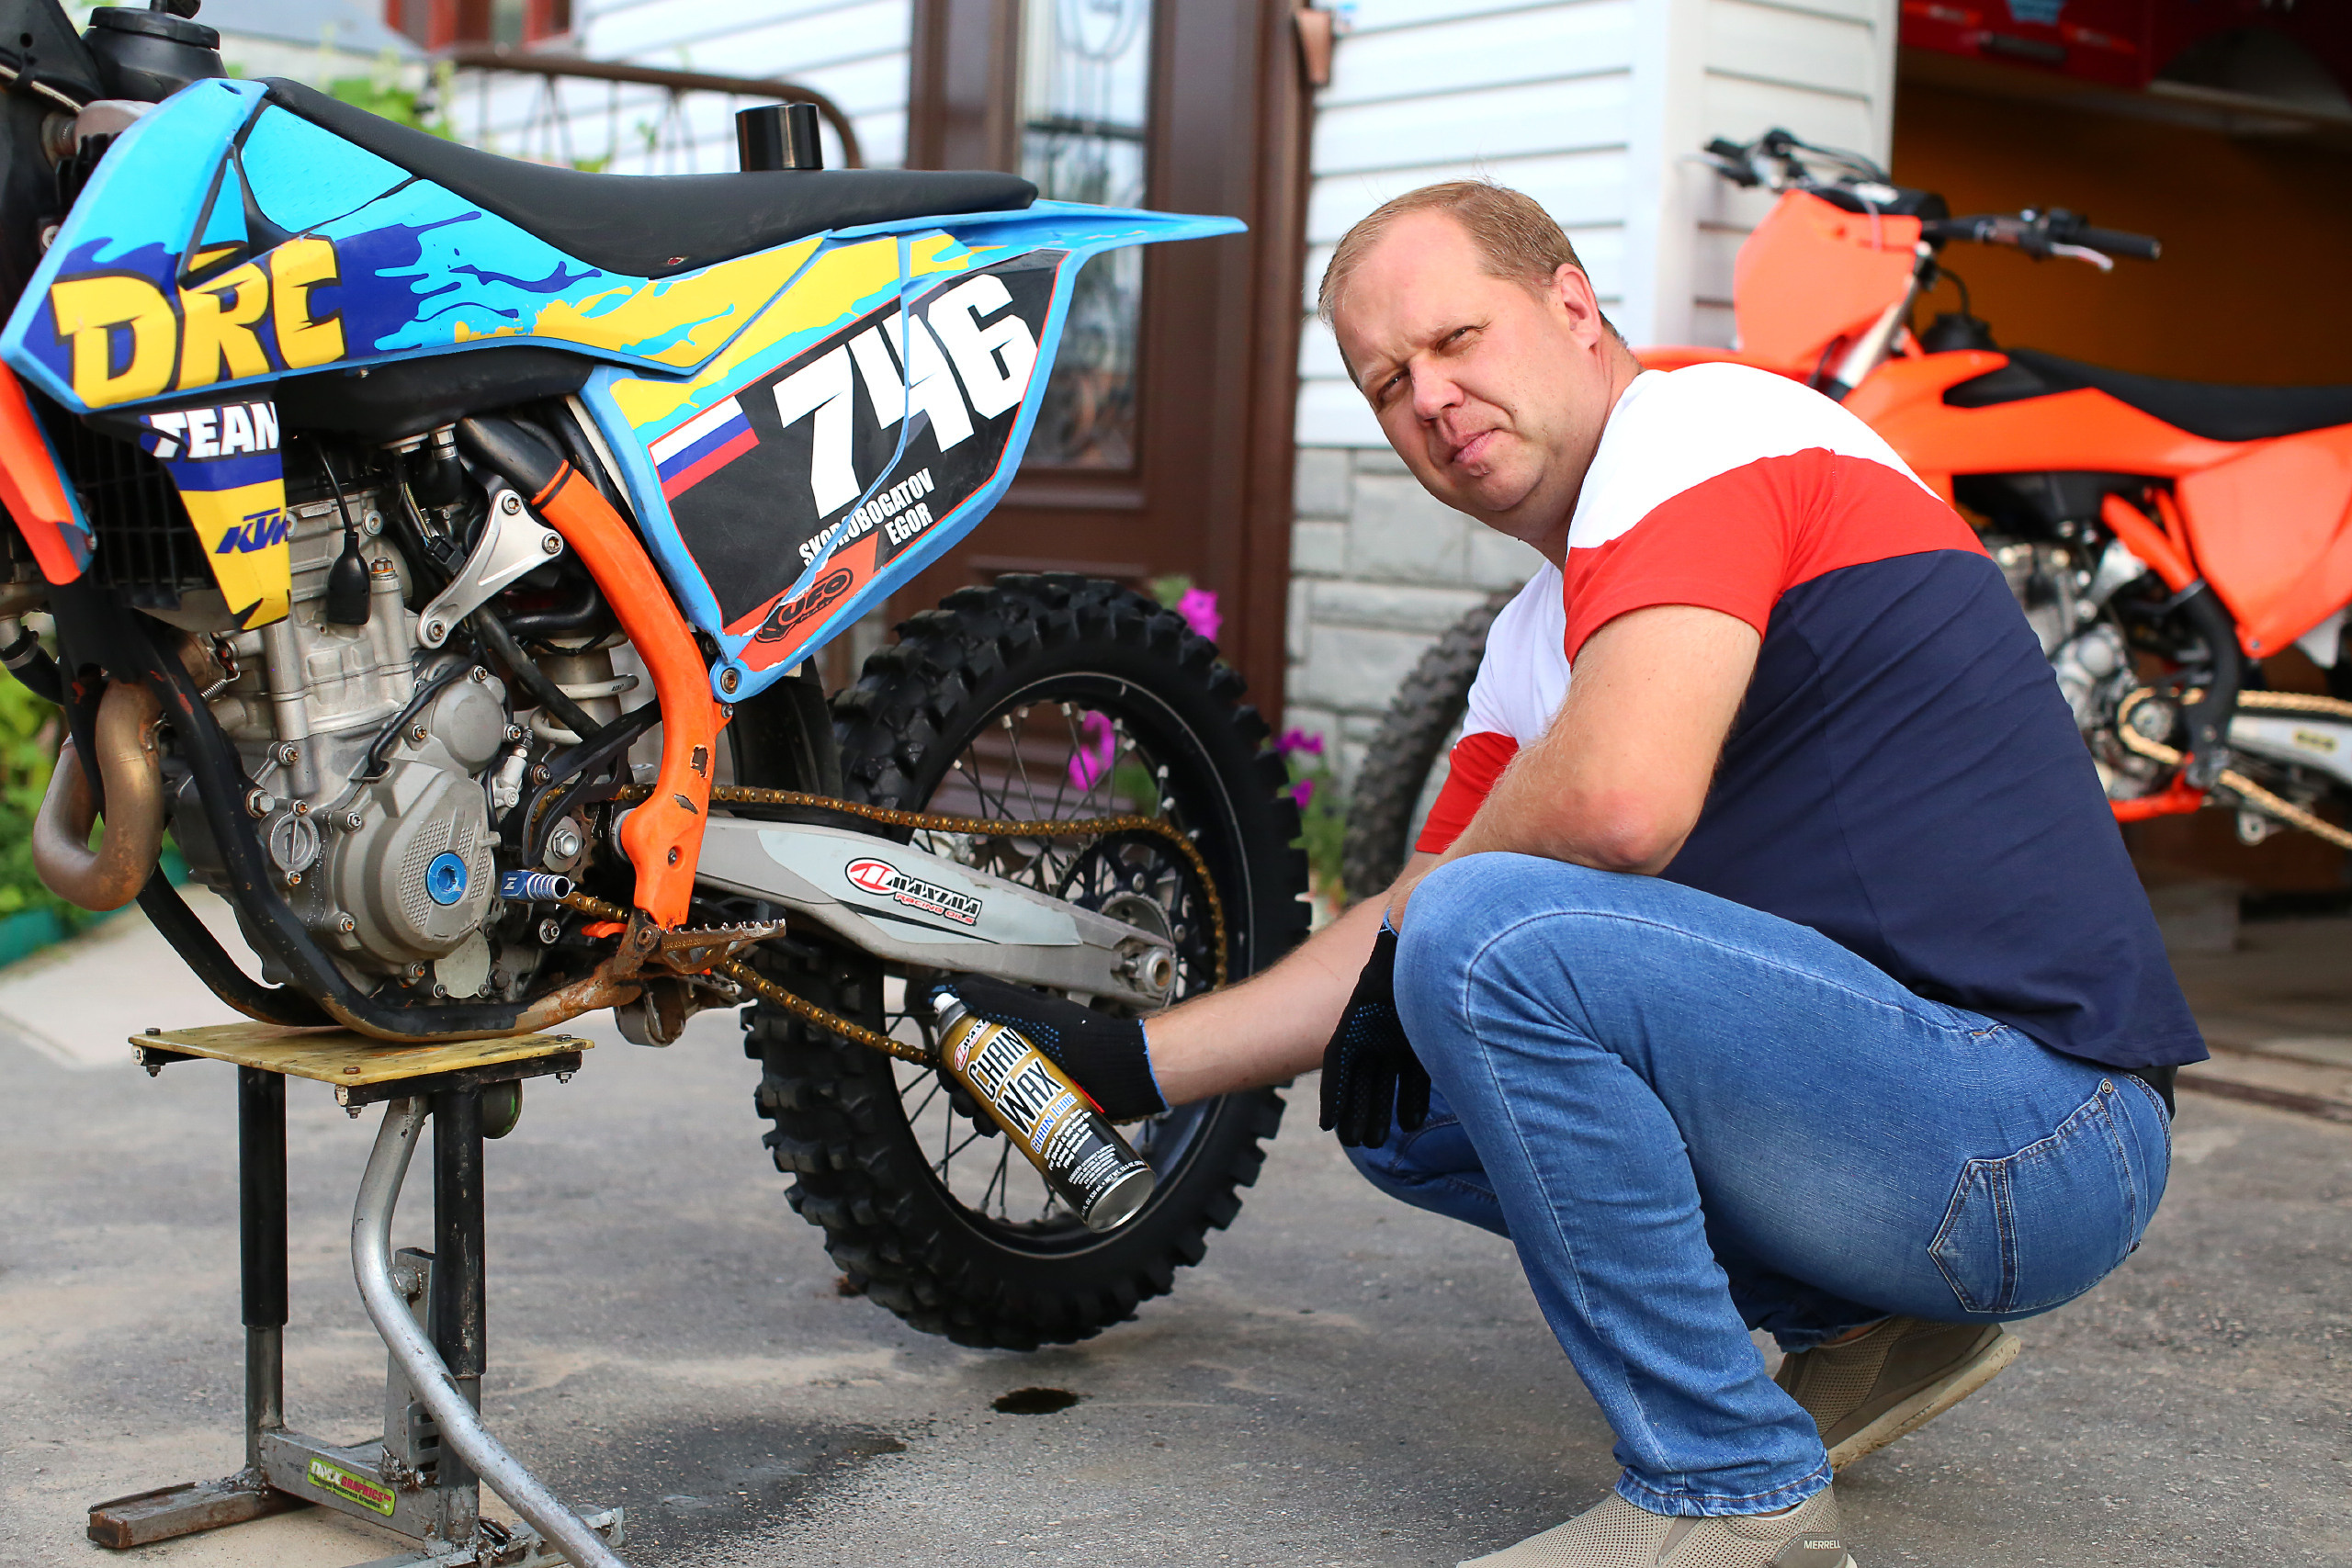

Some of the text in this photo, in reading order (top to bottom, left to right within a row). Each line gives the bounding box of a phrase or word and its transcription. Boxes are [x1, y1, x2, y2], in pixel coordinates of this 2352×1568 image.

[51, 236, 346, 408] DRC
[772, 274, 1038, 520] 746
[885, 502, 934, 547] EGOR
[781, 575, 847, 622] UFO
[886, 876, 980, 916] MAXIMA
[895, 894, 975, 925] RACING OILS
[968, 1026, 1031, 1100] CHAIN
[996, 1059, 1064, 1136] WAX
[1031, 1093, 1077, 1154] CHAIN LUBE
[1804, 1540, 1841, 1550] MERRELL
